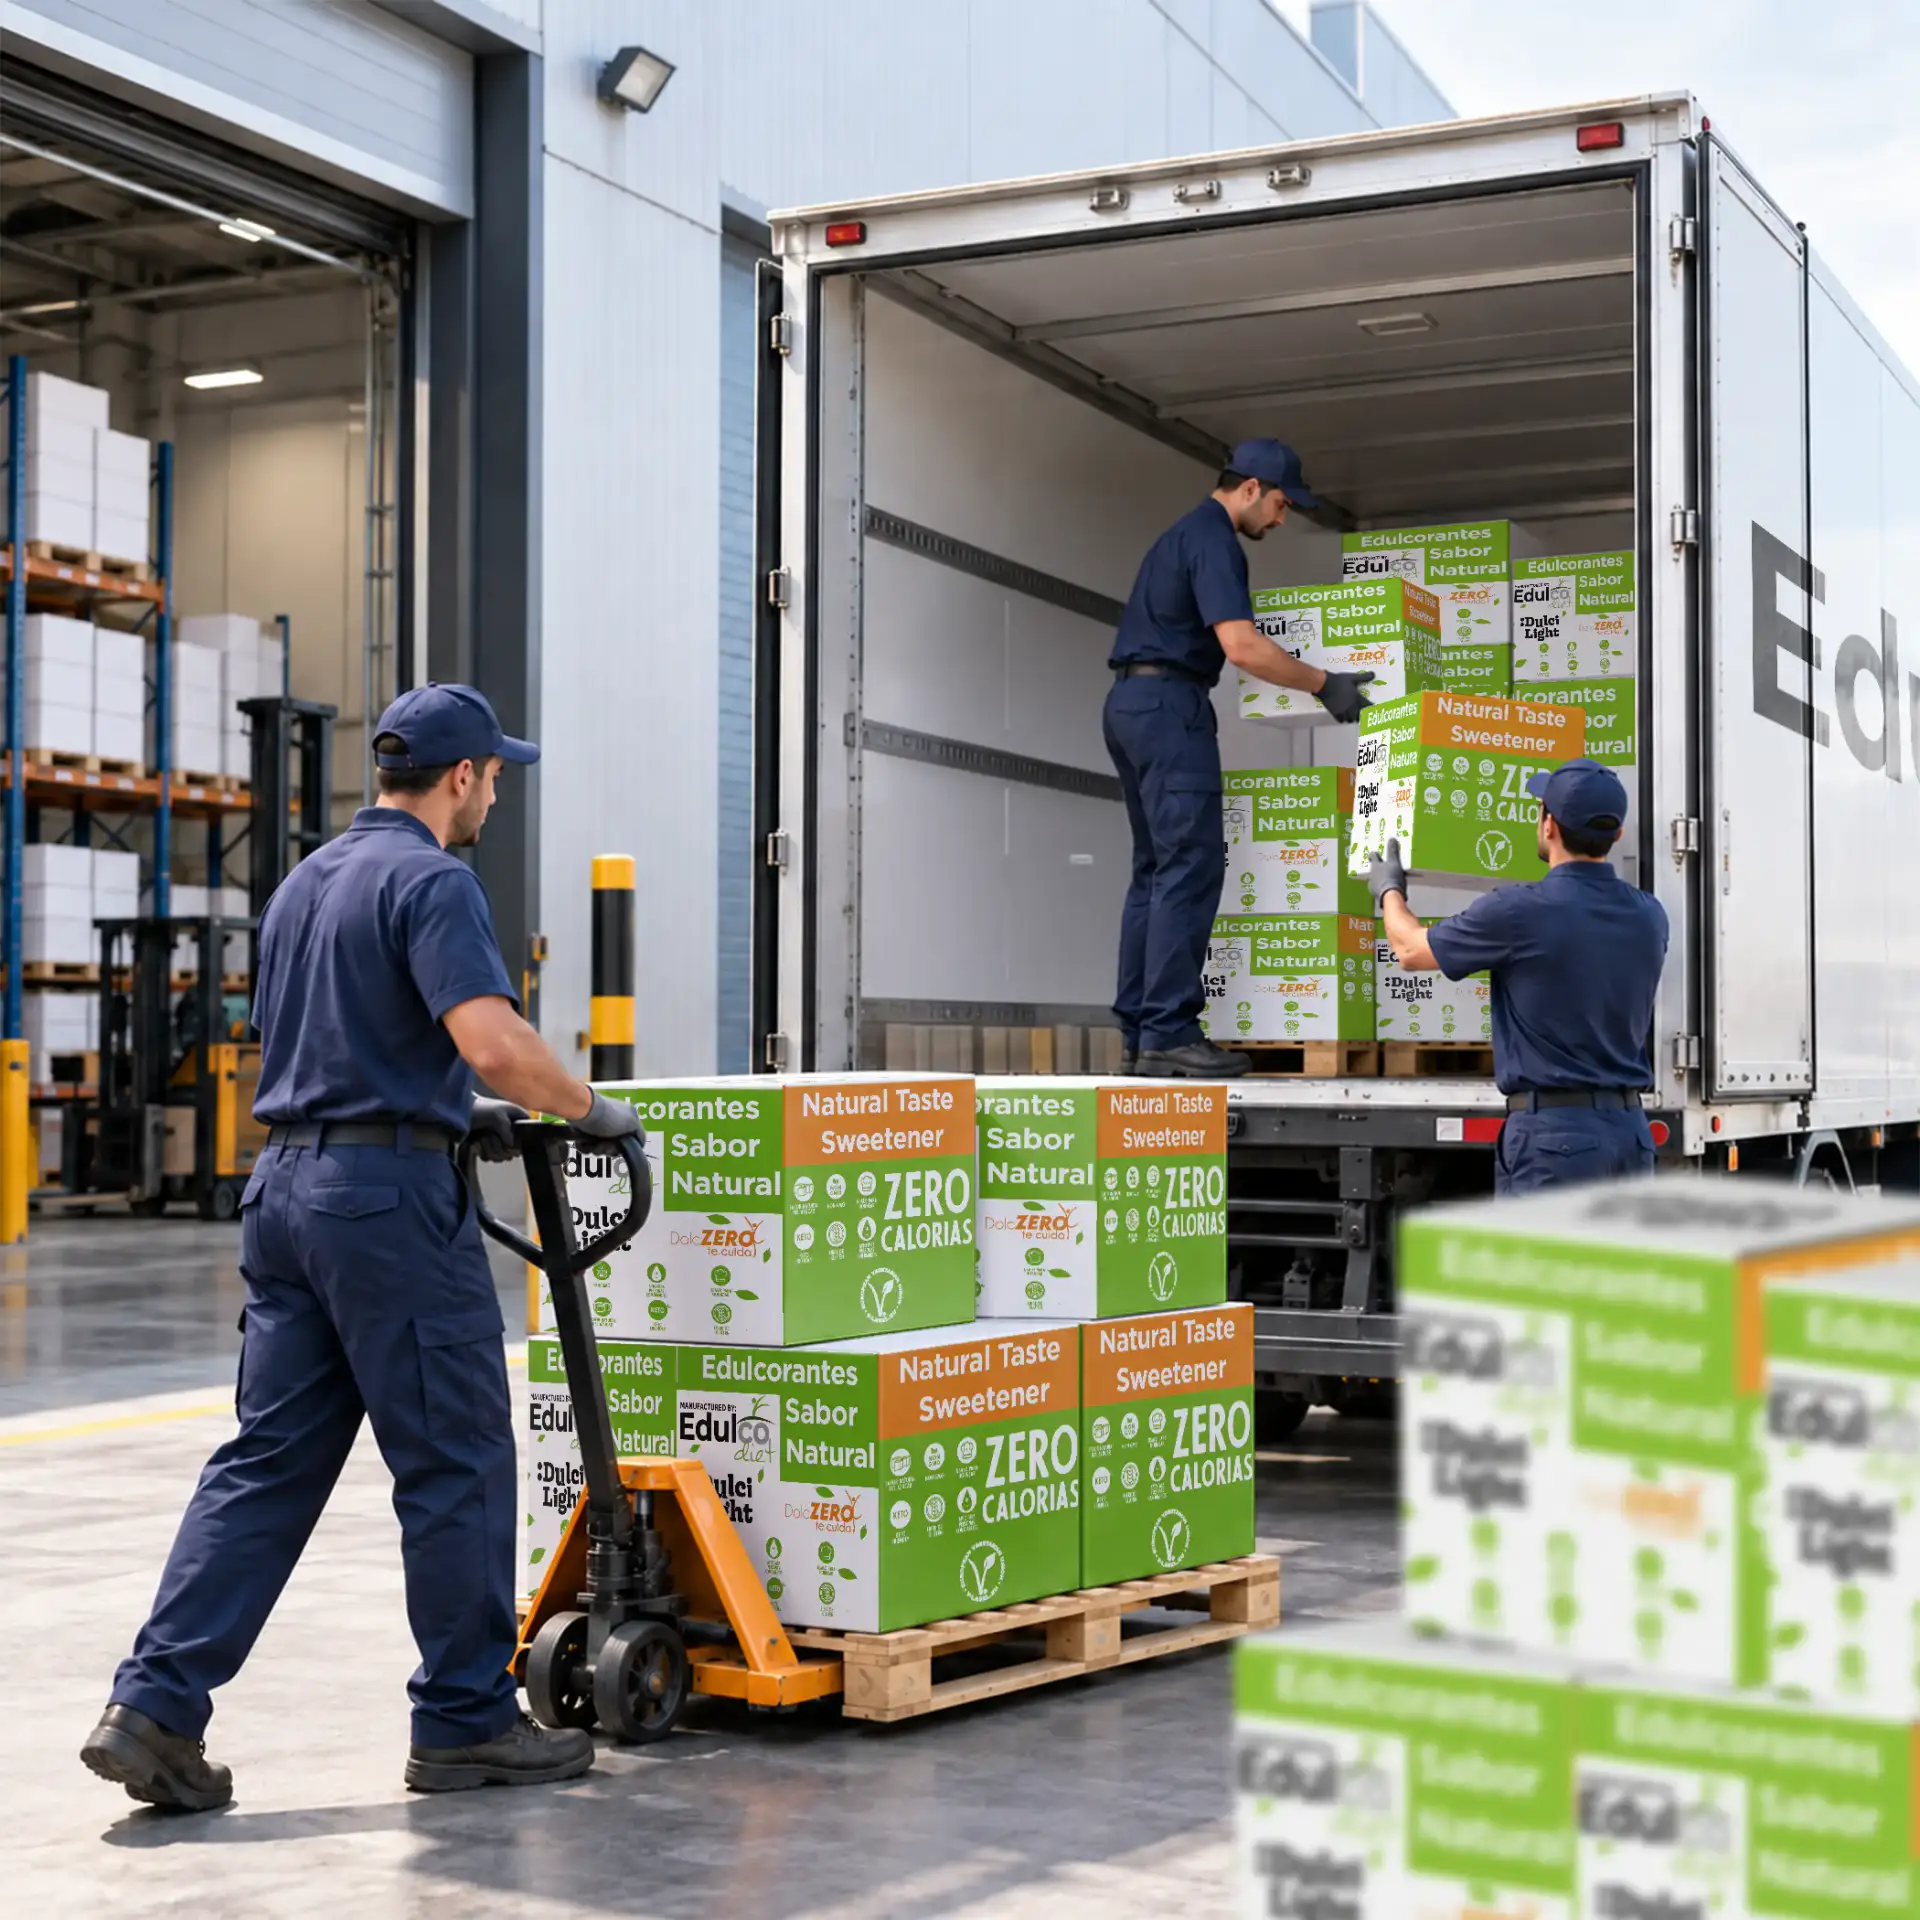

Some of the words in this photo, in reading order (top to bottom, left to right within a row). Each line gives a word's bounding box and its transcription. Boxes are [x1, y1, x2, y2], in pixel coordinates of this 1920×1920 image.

[1361, 528, 1492, 547] Edulcorantes
[1430, 545, 1492, 559] Sabor
[1430, 561, 1507, 577] Natural
[1528, 556, 1623, 573] Edulcorantes
[1579, 574, 1624, 588] Sabor
[1256, 585, 1386, 608] Edulcorantes
[1514, 587, 1570, 603] Edulco
[1580, 591, 1634, 606] Natural
[1326, 604, 1386, 619] Sabor
[1327, 620, 1401, 638] Natural
[1525, 627, 1560, 641] Light
[1443, 665, 1494, 677] abor
[1437, 697, 1509, 721] Natural
[1516, 705, 1566, 728] Taste
[1391, 726, 1416, 744] Sabor
[1451, 725, 1555, 753] Sweetener
[1584, 736, 1632, 755] tural
[1224, 774, 1321, 790] lcorantes
[1258, 794, 1320, 810] Sabor
[1496, 801, 1539, 823] CALO
[1259, 814, 1335, 832] Natural
[1212, 919, 1321, 933] ulcorantes
[1207, 947, 1242, 961] lco
[1257, 937, 1320, 950] Sabor
[1257, 954, 1336, 968] Natural
[1391, 989, 1433, 1002] Light
[803, 1089, 888, 1117] Natural
[896, 1088, 954, 1111] Taste
[1111, 1093, 1168, 1115] Natural
[1173, 1093, 1213, 1113] Taste
[671, 1133, 760, 1158] Sabor
[821, 1128, 944, 1154] Sweetener
[986, 1127, 1075, 1150] Sabor
[1123, 1127, 1206, 1149] Sweetener
[673, 1171, 781, 1196] Natural
[988, 1162, 1093, 1186] Natural
[884, 1167, 970, 1220] ZERO
[1164, 1165, 1224, 1210] ZERO
[881, 1219, 973, 1253] CALORIAS
[1162, 1211, 1226, 1239] CALORIAS
[1100, 1321, 1177, 1354] Natural
[1183, 1317, 1235, 1344] Taste
[702, 1354, 858, 1386] Edulcorantes
[900, 1344, 990, 1383] Natural
[999, 1338, 1060, 1368] Taste
[1117, 1359, 1227, 1392] Sweetener
[609, 1388, 662, 1416] Sabor
[680, 1402, 727, 1412] MANUFACTURED
[727, 1404, 737, 1412] BY:
[785, 1398, 858, 1427] Sabor
[919, 1382, 1050, 1422] Sweetener
[530, 1403, 573, 1432] Edul
[680, 1412, 769, 1445] Edulco
[612, 1427, 675, 1455] Natural
[1172, 1400, 1251, 1459] ZERO
[734, 1438, 776, 1463] diet
[786, 1438, 875, 1469] Natural
[985, 1424, 1077, 1488] ZERO
[1170, 1452, 1253, 1493] CALORIAS
[982, 1479, 1078, 1524] CALORIAS
[892, 1509, 908, 1519] KETO
